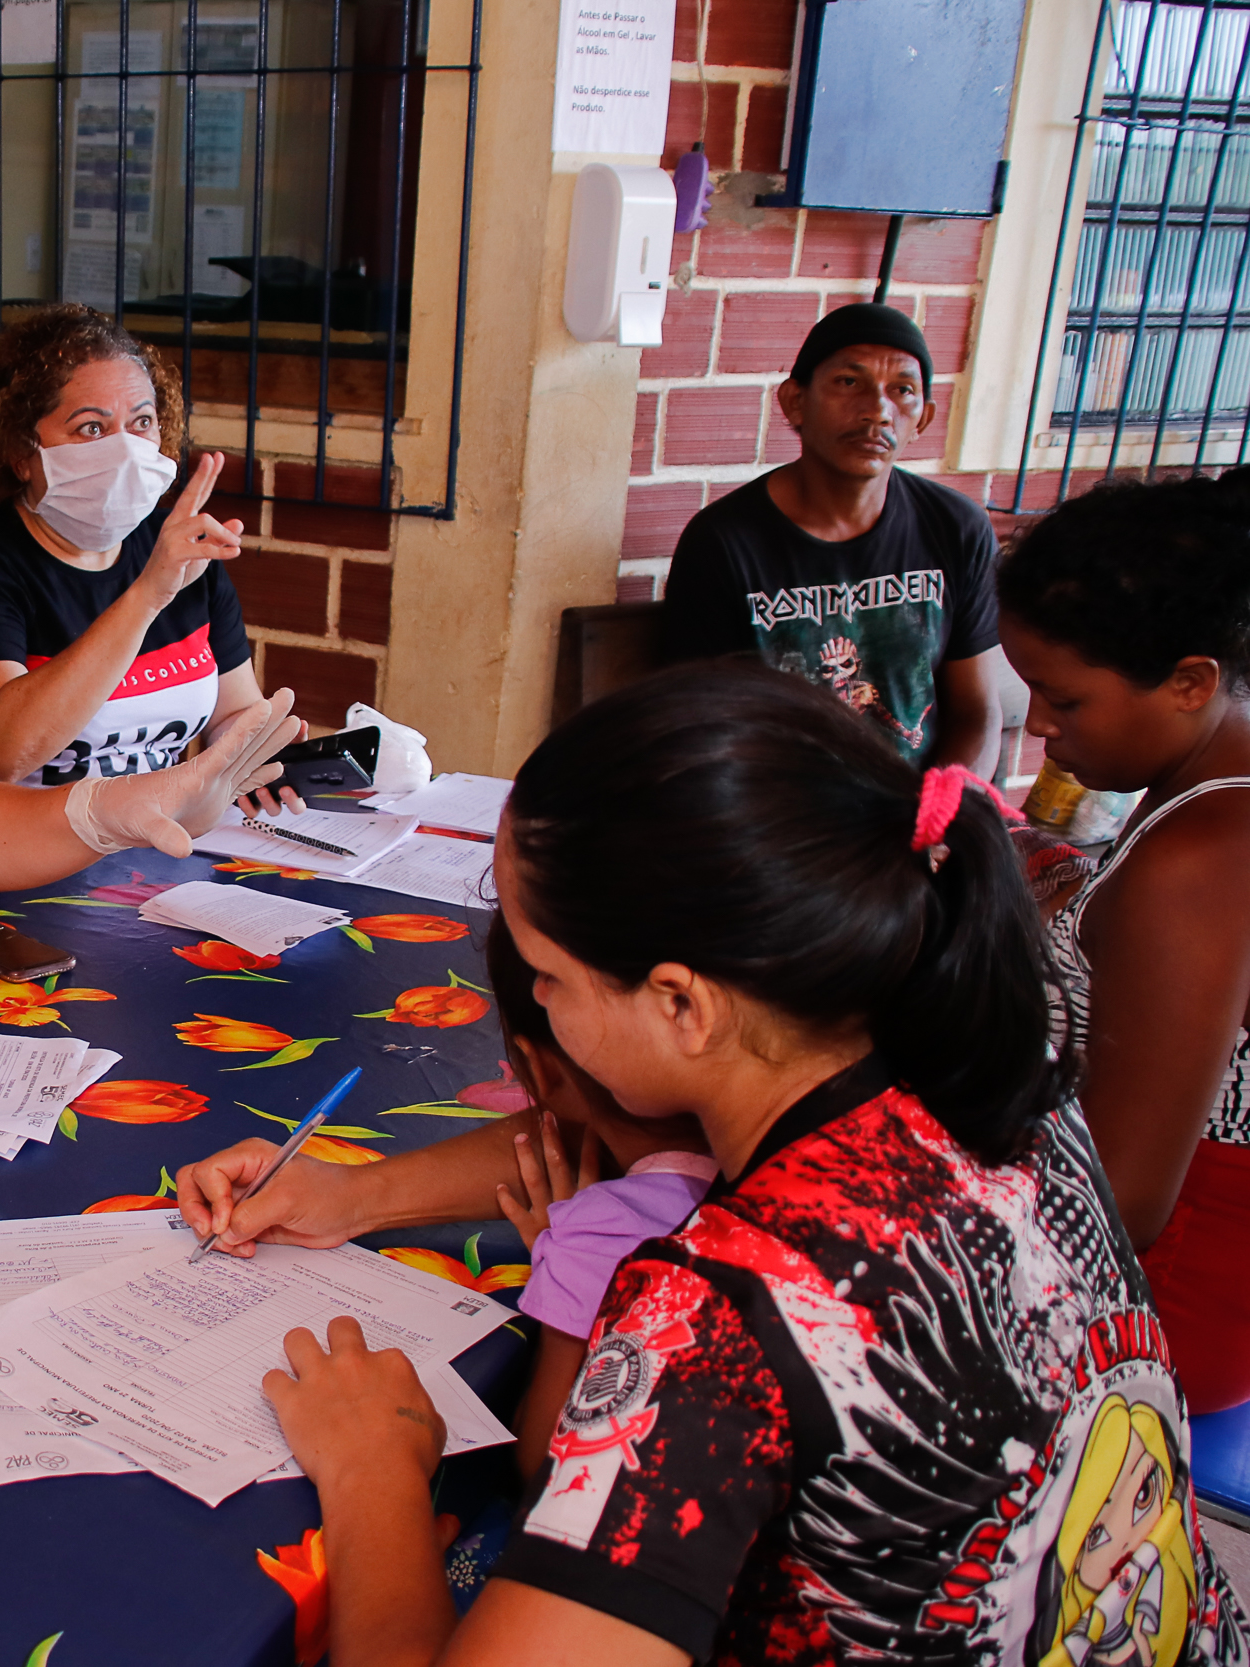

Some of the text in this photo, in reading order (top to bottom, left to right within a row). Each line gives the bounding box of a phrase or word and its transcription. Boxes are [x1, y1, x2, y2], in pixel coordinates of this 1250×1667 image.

[578, 10, 600, 20] Antes
[602, 11, 612, 20] de
[614, 12, 638, 22] Passar
[577, 25, 601, 37] Álcool
[603, 30, 615, 38] em
[617, 29, 629, 39] Gel
[636, 32, 656, 41] Lavar
[576, 45, 610, 55] as Mãos.
[573, 85, 588, 94] Não
[591, 86, 632, 97] desperdice
[572, 103, 605, 112] Produto.
[747, 569, 944, 632] IRON MAIDEN
[16, 1346, 27, 1355] DE
[25, 1353, 62, 1380] MUNICIPAL
[60, 1378, 101, 1403] PREFEITURA
[101, 1382, 120, 1393] ANO
[100, 1402, 112, 1410] DA
[129, 1396, 156, 1412] TURMA
[111, 1408, 145, 1428] MERENDA
[146, 1426, 157, 1434] DE
[172, 1439, 184, 1447] DE
[182, 1434, 197, 1443] EM
[183, 1444, 218, 1462] ENTREGA
[4, 1454, 30, 1468] PAZ
